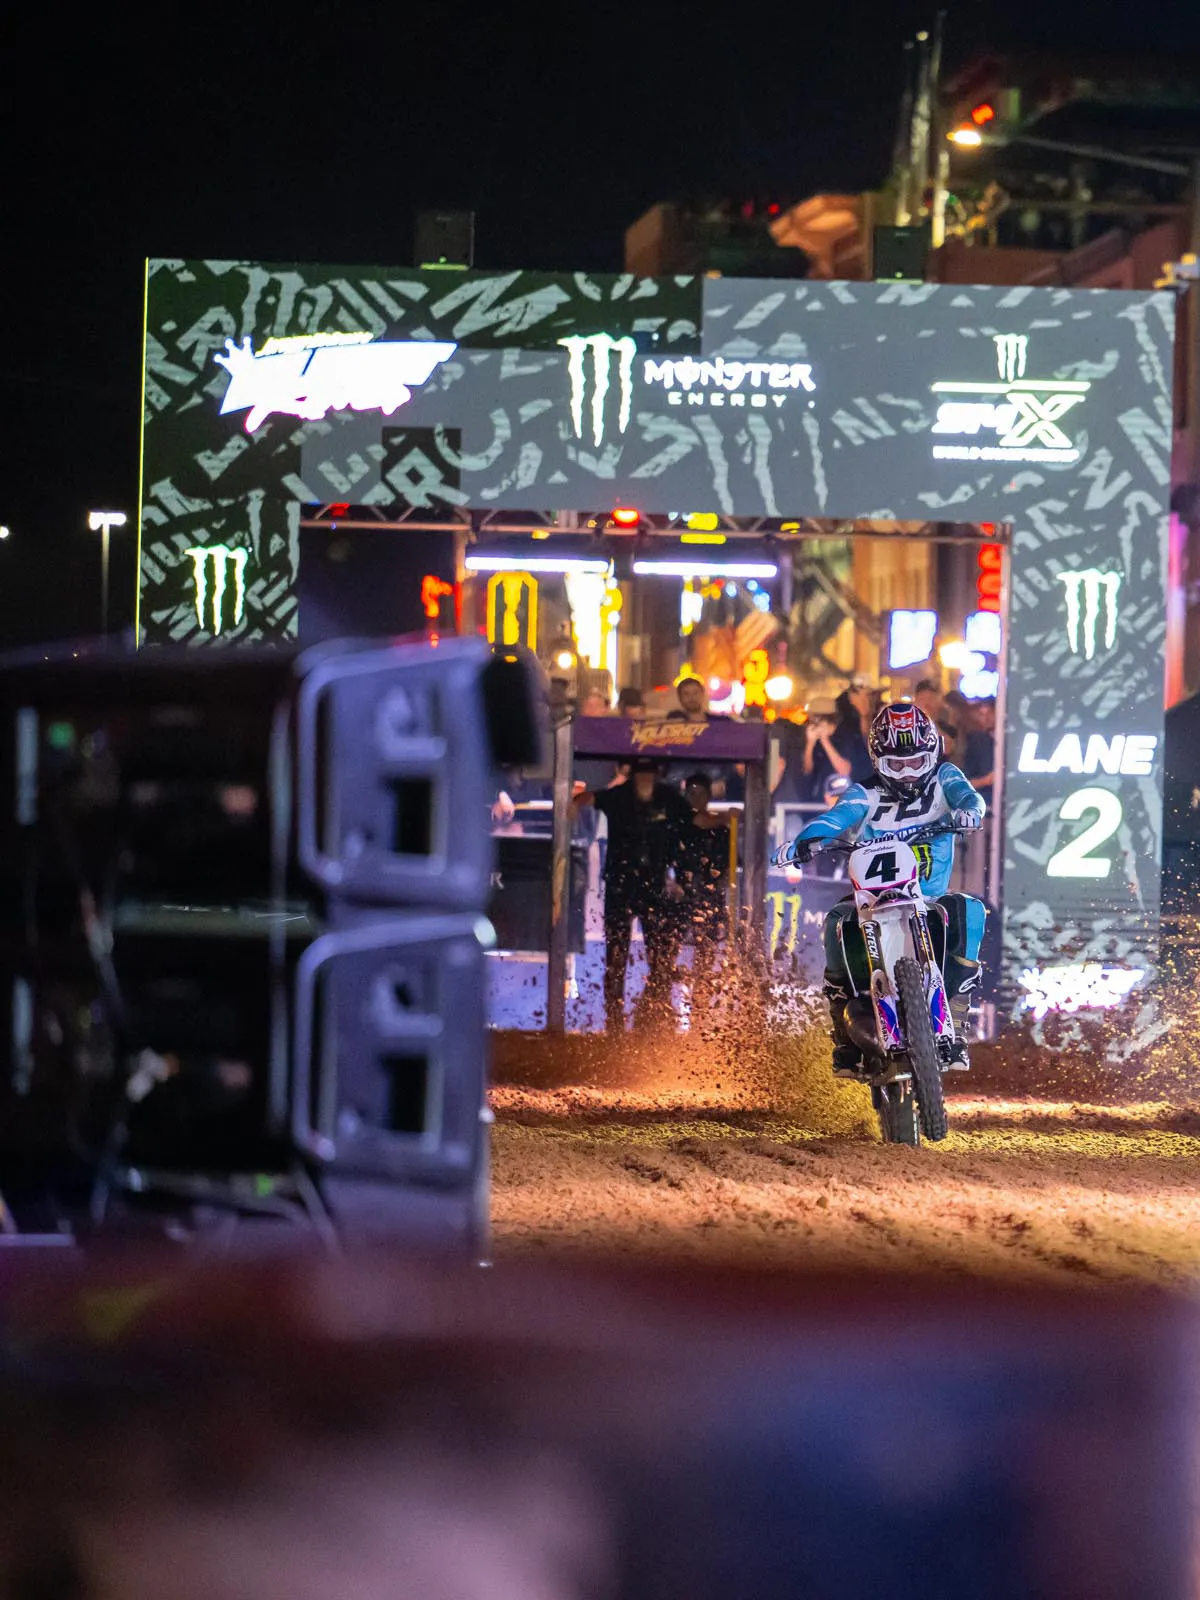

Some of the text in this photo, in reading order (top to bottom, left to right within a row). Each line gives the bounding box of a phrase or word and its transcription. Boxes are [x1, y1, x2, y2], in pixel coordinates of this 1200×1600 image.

[644, 356, 816, 391] MONSTER
[668, 391, 787, 407] ENERGY
[1018, 732, 1158, 775] LANE
[1046, 787, 1123, 878] 2
[865, 851, 900, 883] 4
